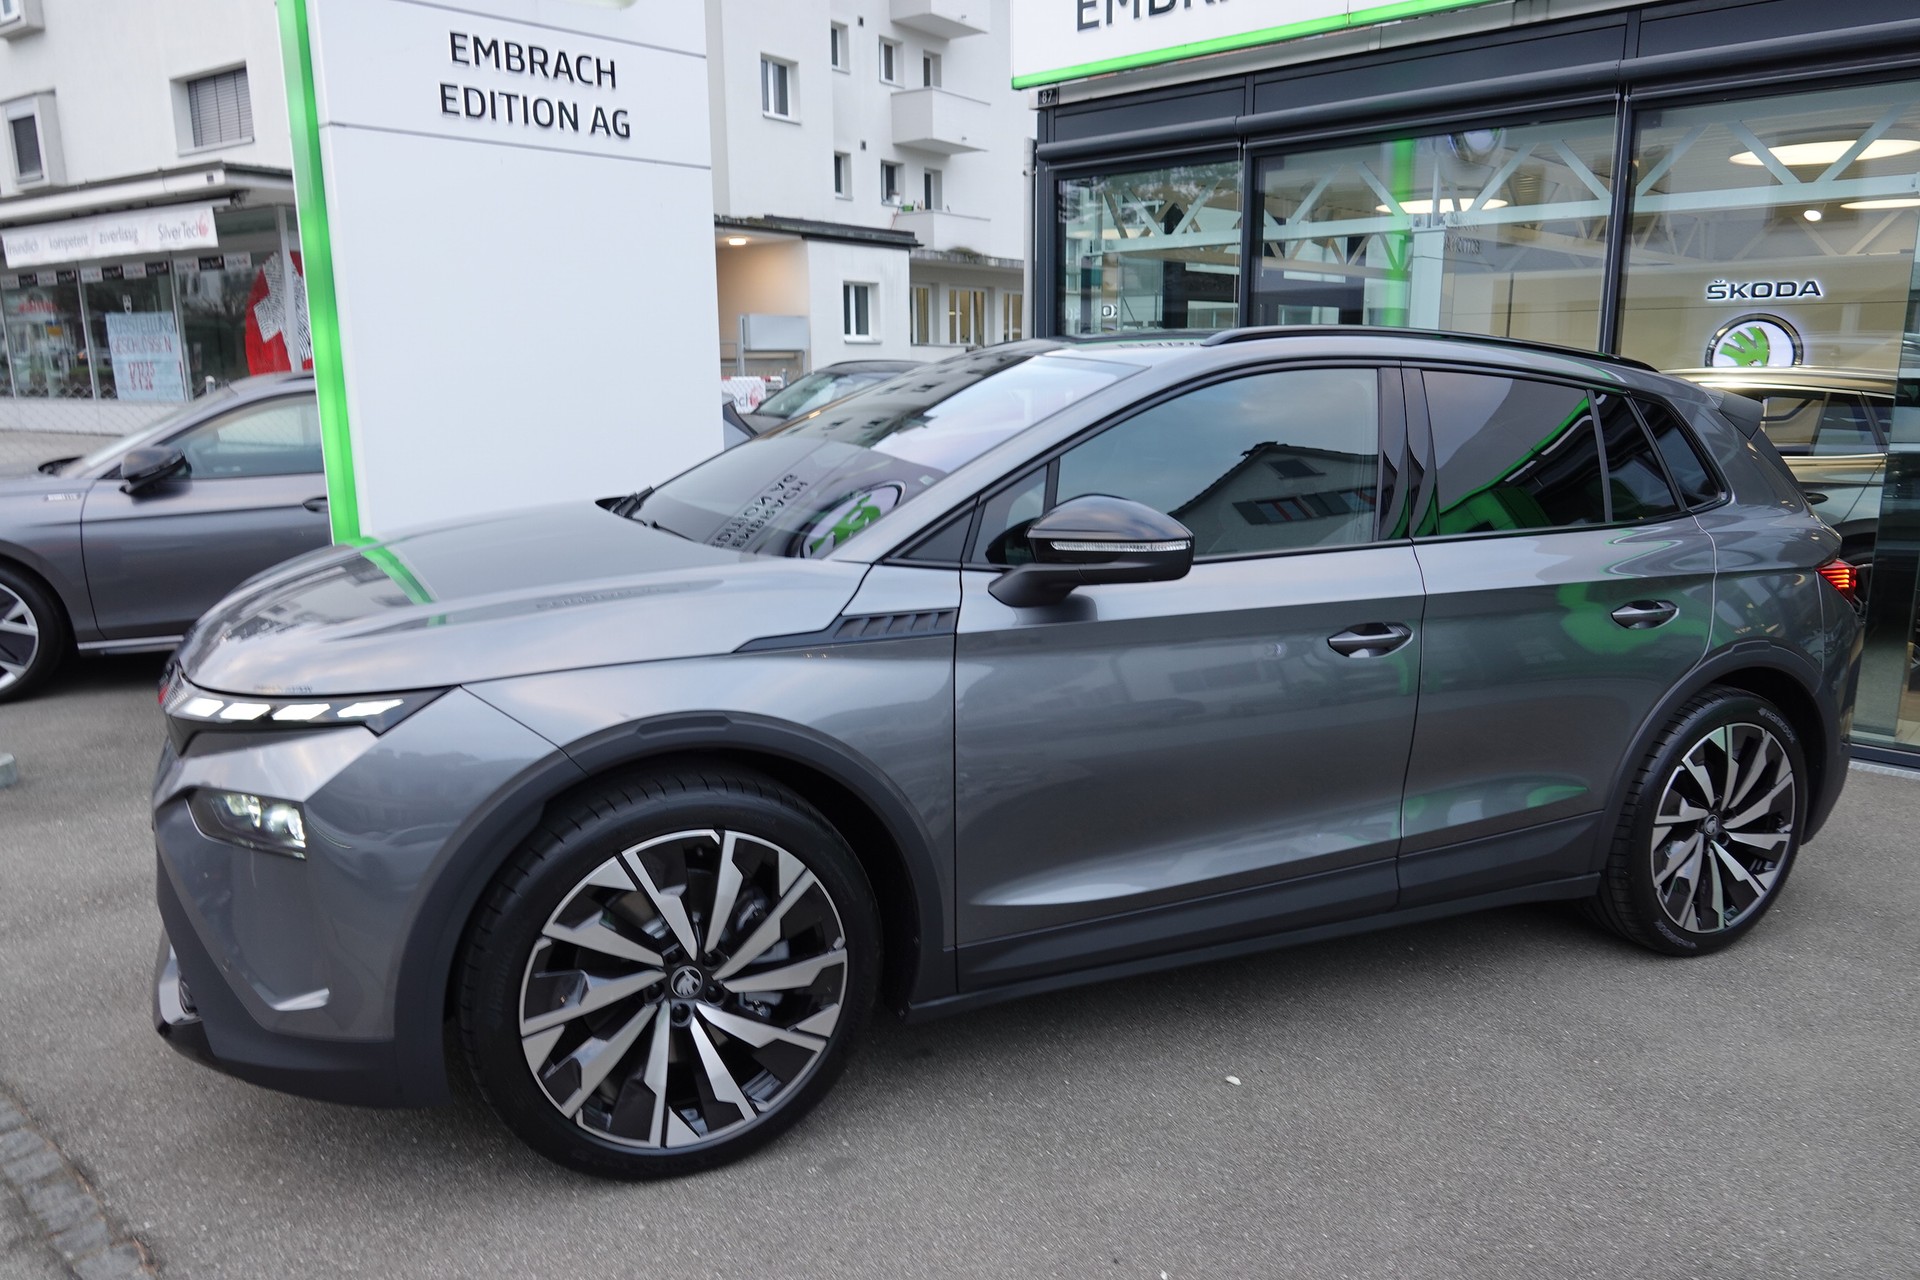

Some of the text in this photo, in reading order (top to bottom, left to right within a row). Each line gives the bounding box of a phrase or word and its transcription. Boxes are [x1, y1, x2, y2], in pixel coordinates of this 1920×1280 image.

[449, 31, 617, 89] EMBRACH
[439, 82, 631, 139] EDITION AG
[1041, 89, 1053, 104] 87
[1707, 280, 1821, 299] ŠKODA
